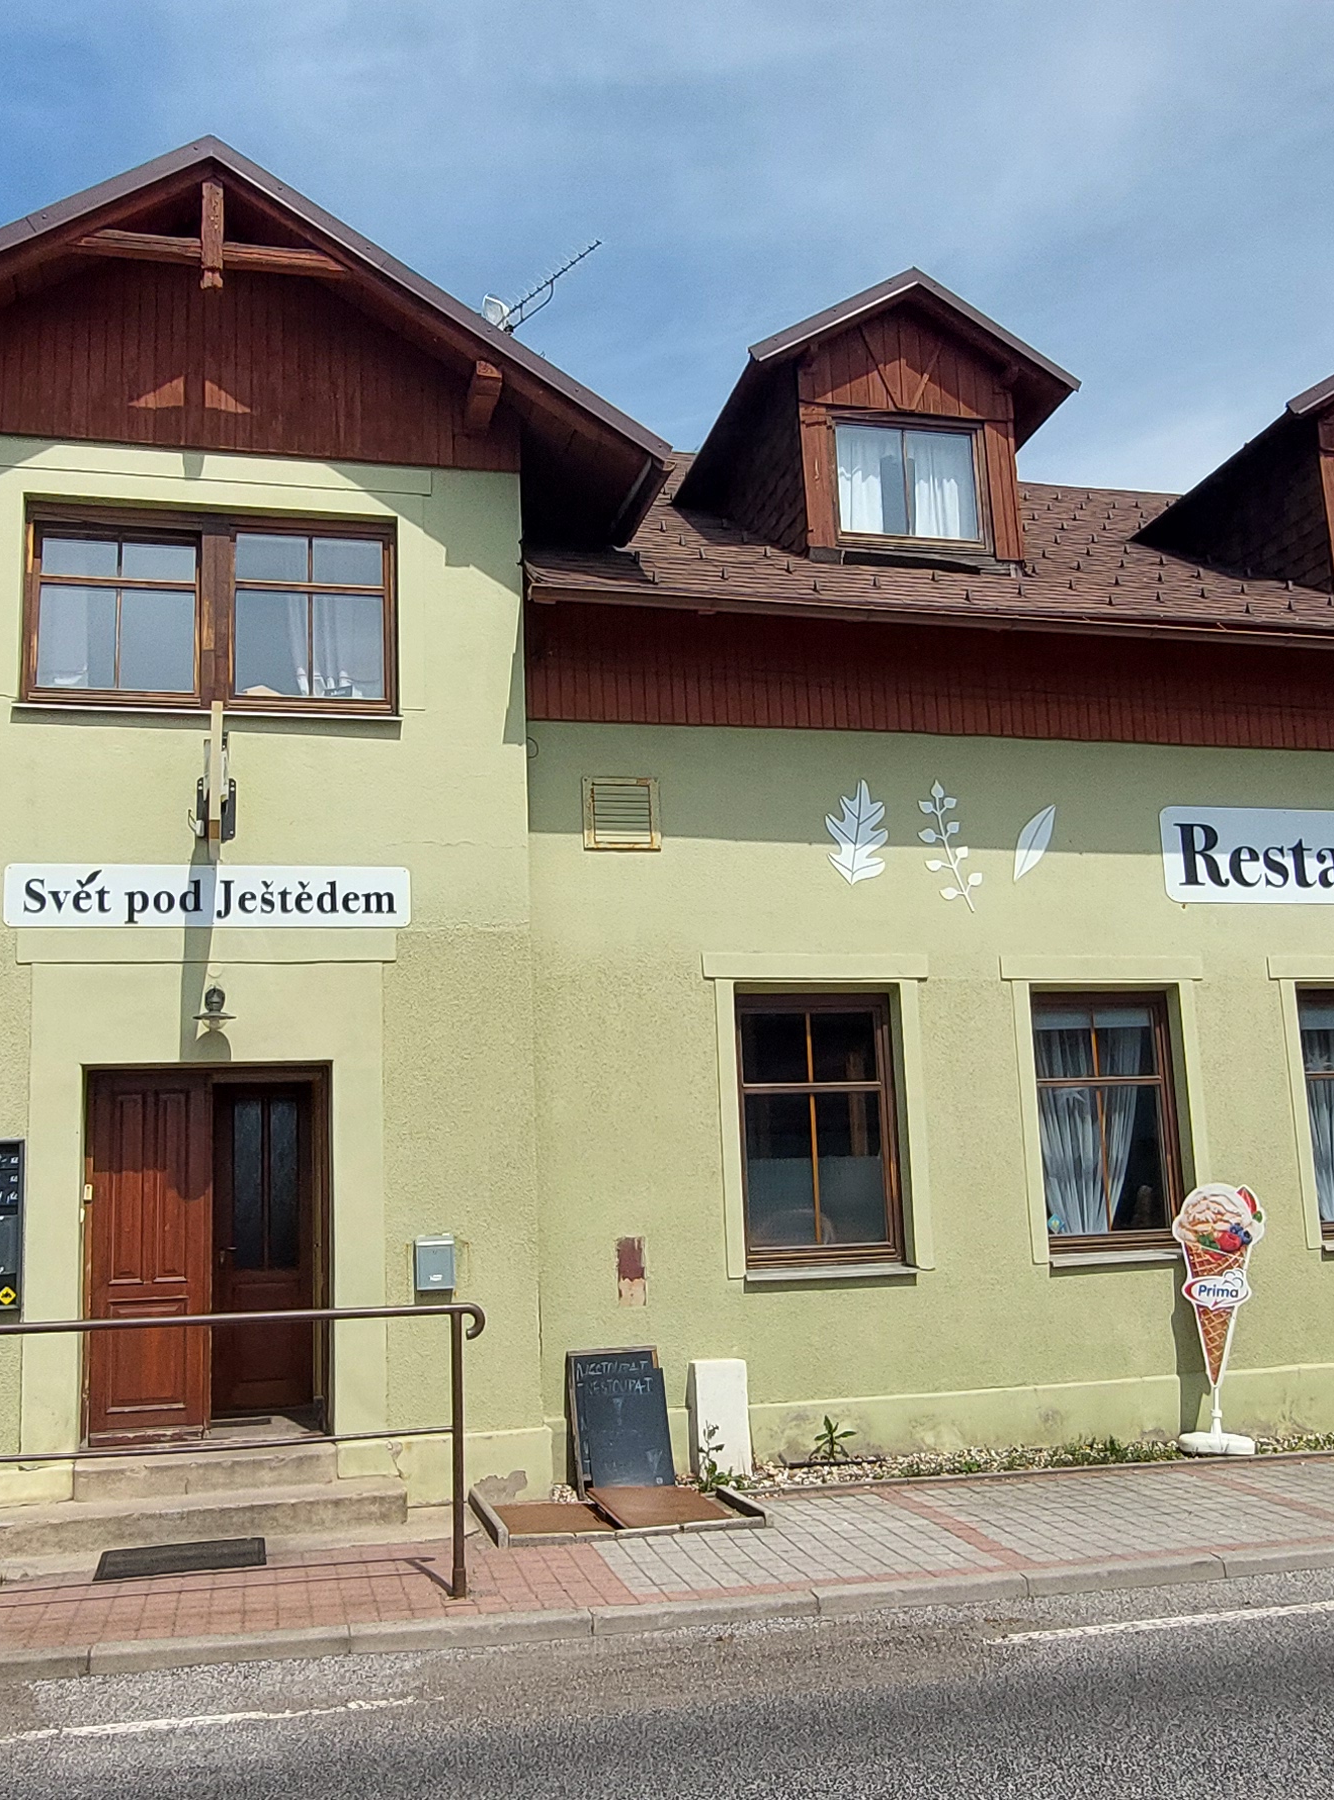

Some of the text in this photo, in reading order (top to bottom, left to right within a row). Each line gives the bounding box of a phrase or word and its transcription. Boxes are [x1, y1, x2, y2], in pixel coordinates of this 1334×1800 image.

[23, 870, 397, 924] Svět pod Ještědem
[1198, 1284, 1239, 1298] Prima
